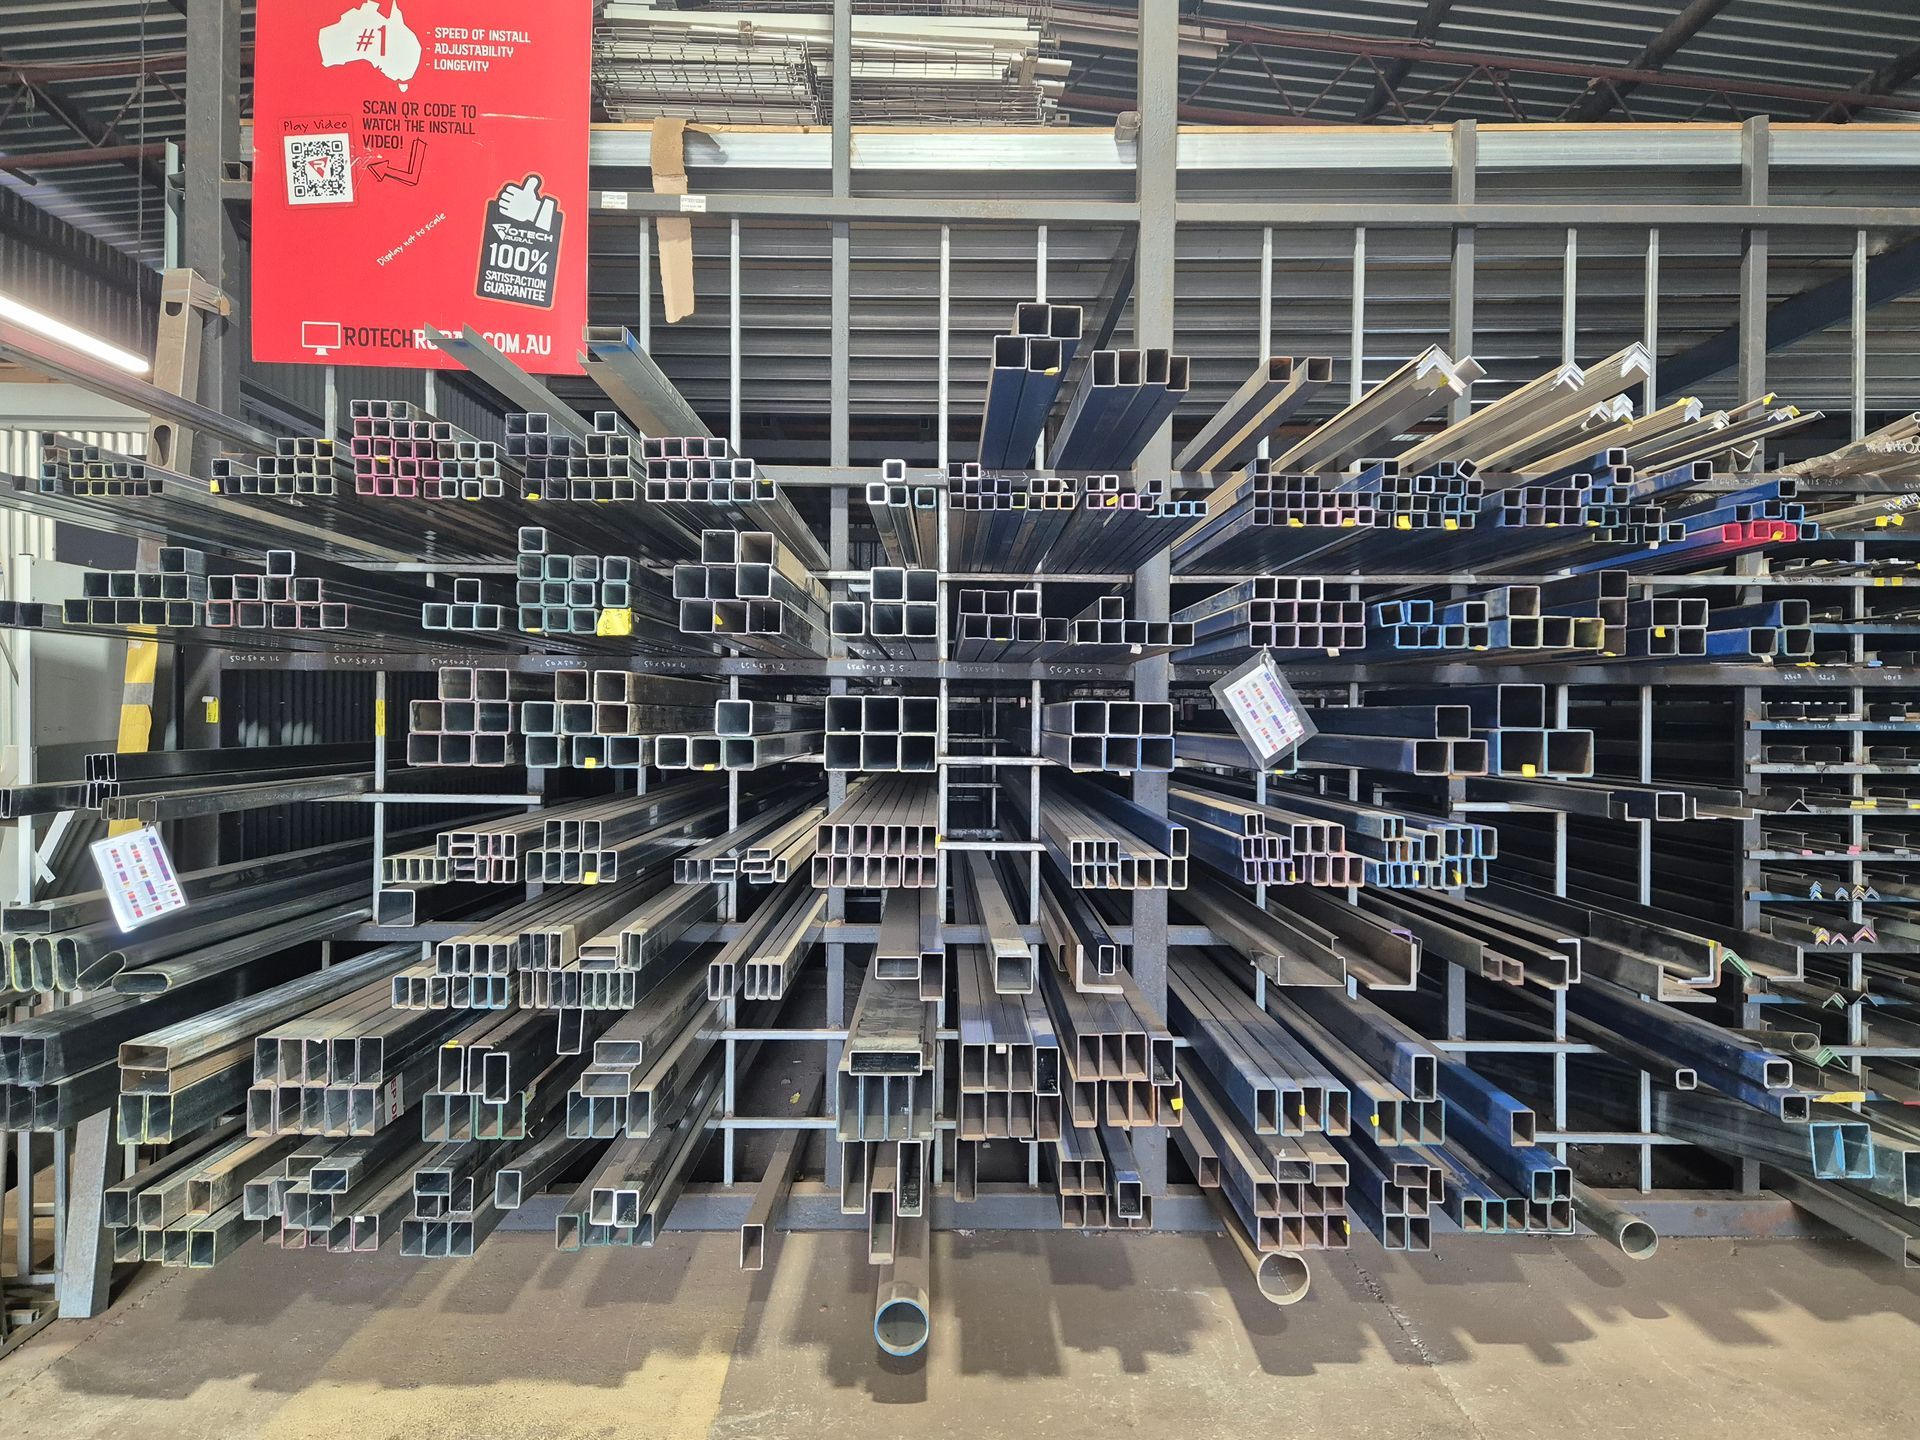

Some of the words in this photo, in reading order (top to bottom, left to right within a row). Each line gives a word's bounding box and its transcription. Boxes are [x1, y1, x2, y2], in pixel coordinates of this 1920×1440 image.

[356, 25, 386, 57] #1
[434, 27, 469, 40] SPEED
[472, 29, 485, 40] OF
[489, 31, 531, 43] INSTALL
[434, 43, 514, 57] ADJUSTABILITY
[434, 59, 489, 72] LONGEVITY
[362, 100, 397, 115] SCAN
[401, 102, 419, 118] QR
[423, 104, 457, 118] CODE
[460, 104, 477, 118] TO
[283, 120, 309, 133] Play
[313, 119, 348, 131] Video
[362, 118, 401, 132] WATCH
[404, 120, 425, 133] THE
[429, 122, 476, 135] INSTALL
[362, 134, 404, 150] VIDEO!
[376, 245, 404, 266] Display
[403, 235, 416, 247] not
[415, 228, 426, 237] to
[425, 212, 446, 231] scale
[492, 223, 554, 243] ROTECH
[489, 242, 550, 275] 100%
[485, 269, 547, 290] SATISFACTION
[483, 280, 546, 302] GUARANTEE
